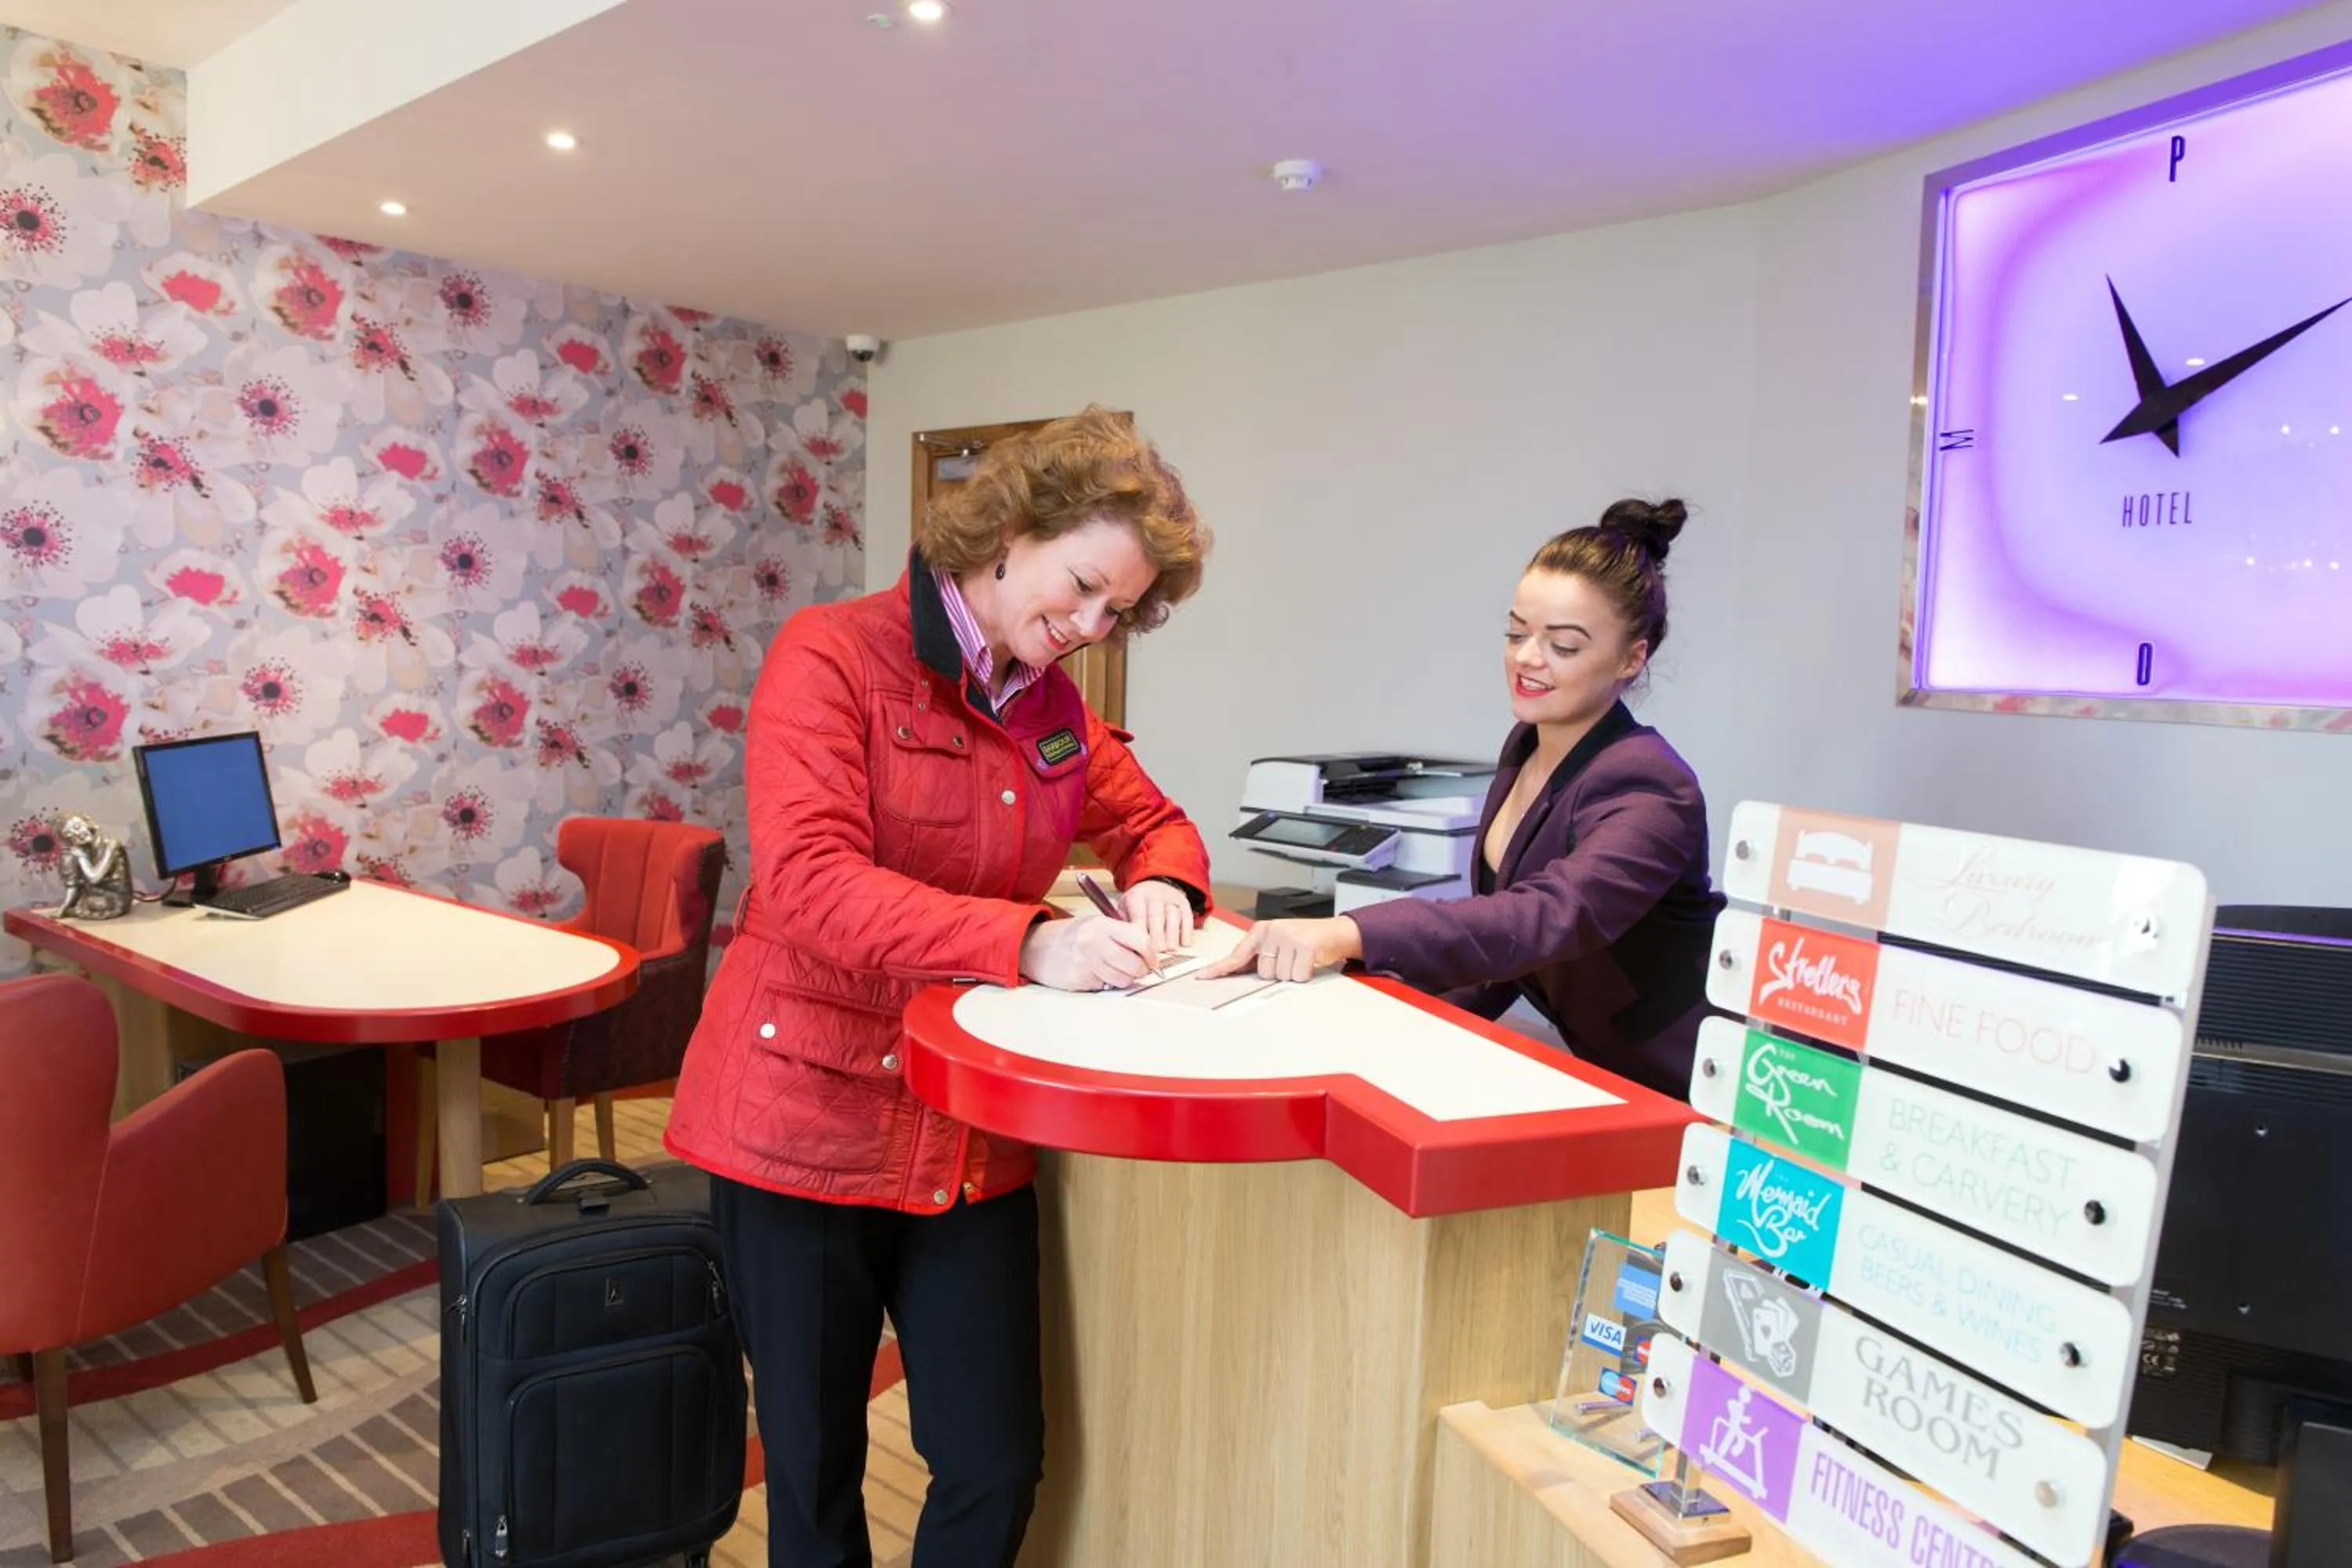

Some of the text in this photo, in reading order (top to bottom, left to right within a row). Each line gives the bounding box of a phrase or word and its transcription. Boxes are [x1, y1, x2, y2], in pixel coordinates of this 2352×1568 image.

[2169, 134, 2187, 183] P
[2122, 490, 2193, 528] HOTEL
[1746, 1042, 1839, 1098] Green
[1893, 987, 2097, 1075] FINE FOOD
[1744, 1080, 1846, 1145] Room
[1889, 1098, 2081, 1190] BREAKFAST
[1735, 1158, 1832, 1232] Mermaid
[1879, 1142, 2071, 1240] & CARVERY
[1857, 1222, 2060, 1334] CASUAL DINING
[1860, 1254, 2042, 1364] BEERS & WINES
[1590, 1320, 1623, 1346] VISA
[1855, 1334, 2024, 1450] GAMES
[1863, 1376, 2000, 1479] ROOM
[1810, 1451, 2004, 1568] FITNESS CENT
